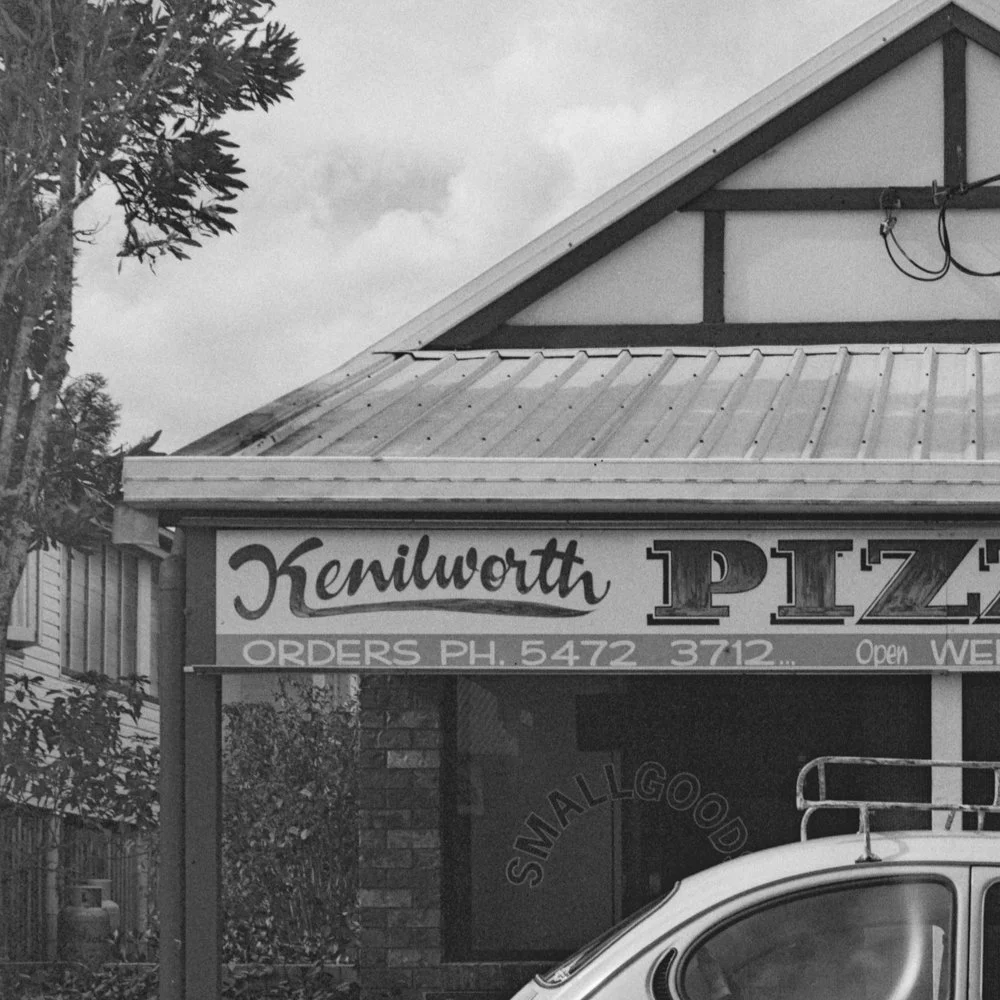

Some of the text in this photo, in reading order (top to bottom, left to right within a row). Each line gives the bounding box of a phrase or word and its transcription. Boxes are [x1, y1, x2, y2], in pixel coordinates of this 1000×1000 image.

[228, 534, 611, 620] Kenilworth
[242, 639, 421, 667] ORDERS
[440, 640, 505, 667] PH.
[521, 639, 637, 667] 5472
[856, 638, 909, 668] Open
[505, 761, 751, 889] SMALLGOOD
